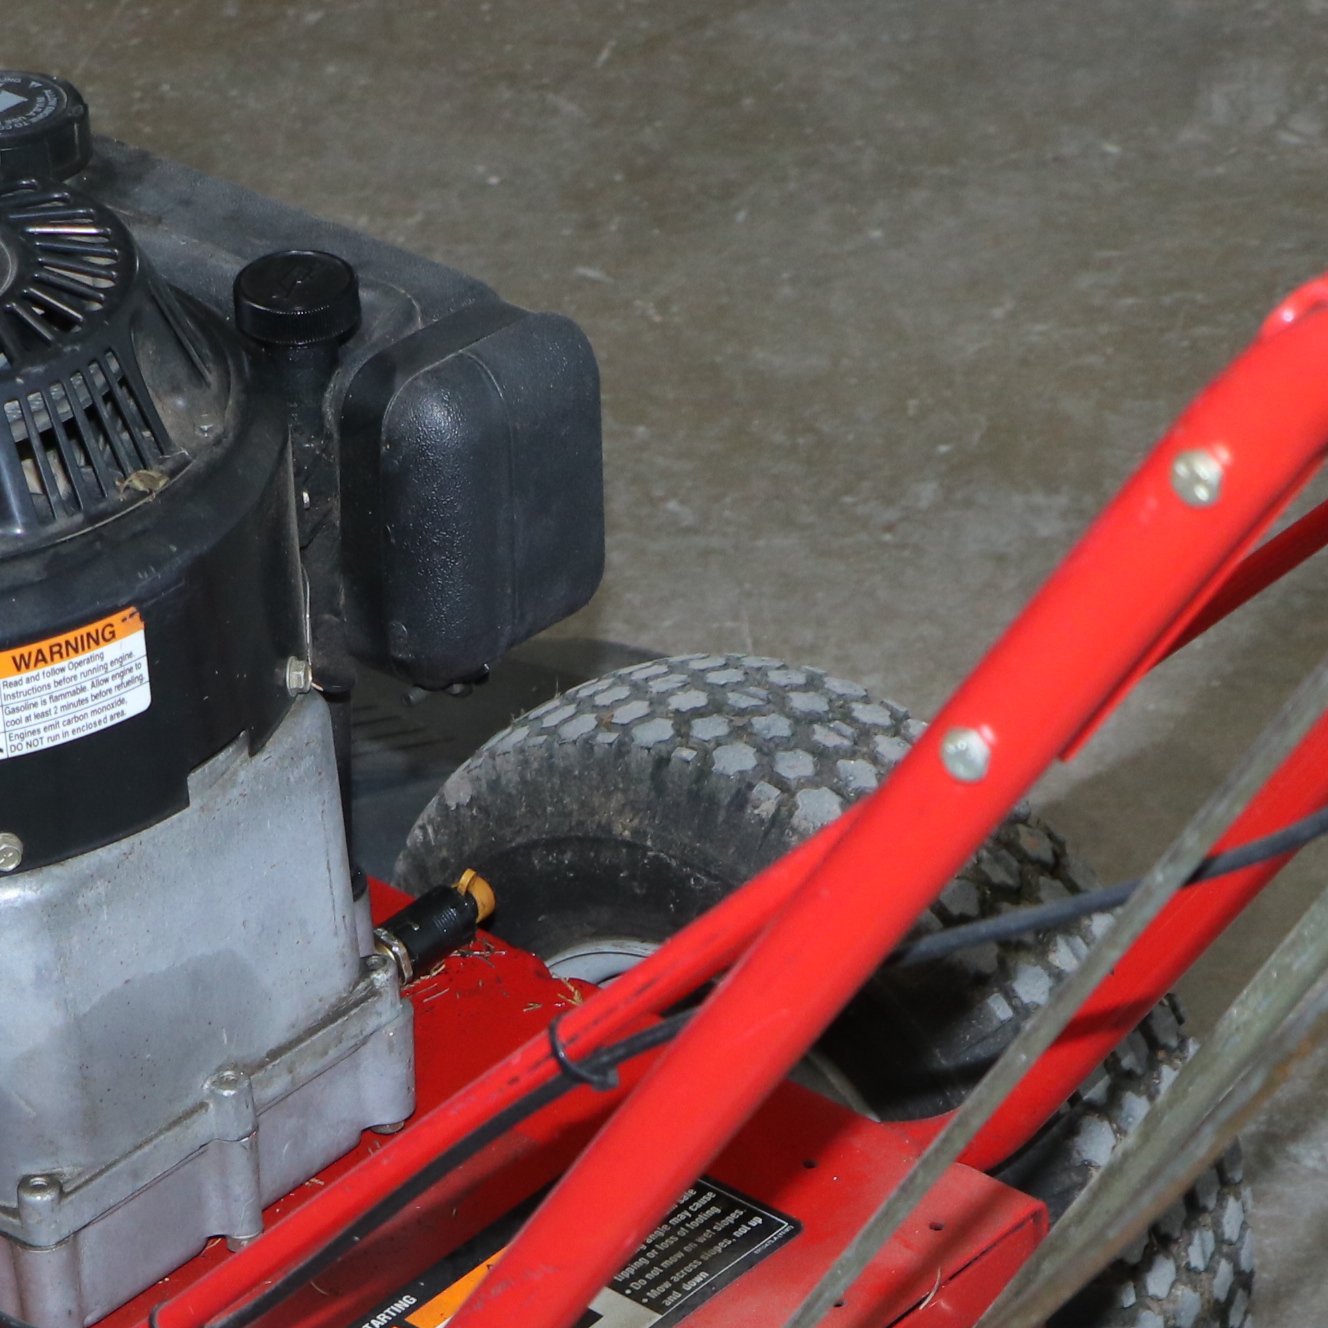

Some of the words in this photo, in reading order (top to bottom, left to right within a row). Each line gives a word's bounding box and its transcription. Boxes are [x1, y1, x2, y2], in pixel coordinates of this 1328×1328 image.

[2, 675, 23, 690] Read
[25, 672, 39, 683] and
[42, 663, 65, 678] follow
[68, 650, 103, 673] Operating
[11, 621, 116, 674] WARNING
[3, 679, 51, 702] Instructions
[53, 672, 77, 688] before
[80, 661, 108, 681] running
[110, 649, 135, 669] engine.
[4, 698, 38, 717] Gasoline
[40, 696, 46, 706] is
[49, 683, 88, 704] flammable.
[90, 674, 109, 689] Allow
[111, 664, 133, 682] engine
[135, 660, 141, 670] to
[6, 715, 22, 727] cool
[25, 713, 31, 723] at
[34, 707, 51, 720] least
[53, 705, 57, 714] 2
[60, 695, 89, 712] minutes
[91, 685, 112, 701] before
[114, 672, 145, 694] refueling.
[8, 724, 42, 744] Engines
[43, 719, 59, 732] emit
[62, 710, 88, 726] carbon
[90, 696, 127, 716] monoxide,
[10, 741, 23, 753] DO
[26, 736, 44, 748] NOT
[47, 732, 60, 742] run
[62, 728, 69, 738] in
[71, 715, 107, 735] enclosed
[110, 708, 126, 721] area.
[645, 1223, 671, 1244] angle
[669, 1209, 692, 1227] may
[689, 1191, 716, 1211] cause
[614, 1257, 650, 1282] tipping
[646, 1250, 659, 1259] or
[656, 1236, 679, 1251] loss
[677, 1226, 689, 1236] of
[630, 1277, 647, 1291] Do
[645, 1267, 664, 1280] not
[661, 1251, 685, 1268] mow
[684, 1242, 698, 1252] on
[697, 1229, 715, 1244] wet
[647, 1280, 672, 1299] Mow
[670, 1260, 702, 1282] across
[700, 1238, 737, 1261] slopes,
[732, 1224, 751, 1238] not
[748, 1216, 763, 1227] up
[662, 1292, 682, 1307] and
[682, 1271, 709, 1291] down
